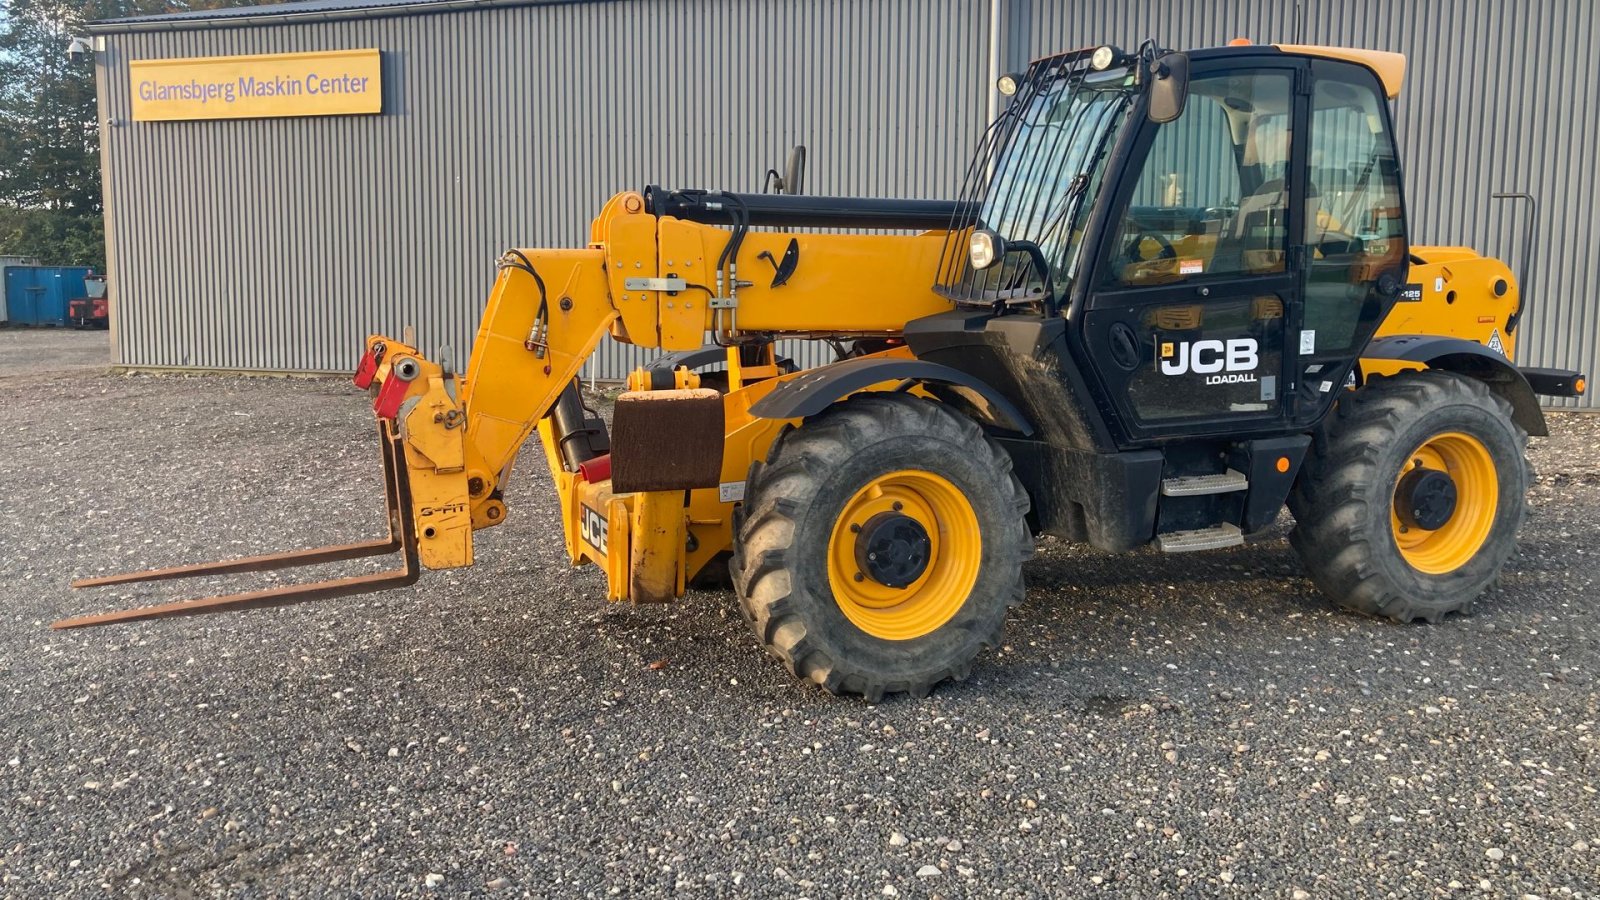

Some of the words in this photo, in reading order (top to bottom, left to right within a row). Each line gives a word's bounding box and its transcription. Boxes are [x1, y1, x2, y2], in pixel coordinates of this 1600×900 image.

[139, 79, 235, 103] Glamsbjerg
[239, 75, 302, 97] Maskin
[305, 73, 369, 95] Center
[1161, 338, 1259, 375] JCB
[1206, 373, 1257, 385] LOADALL
